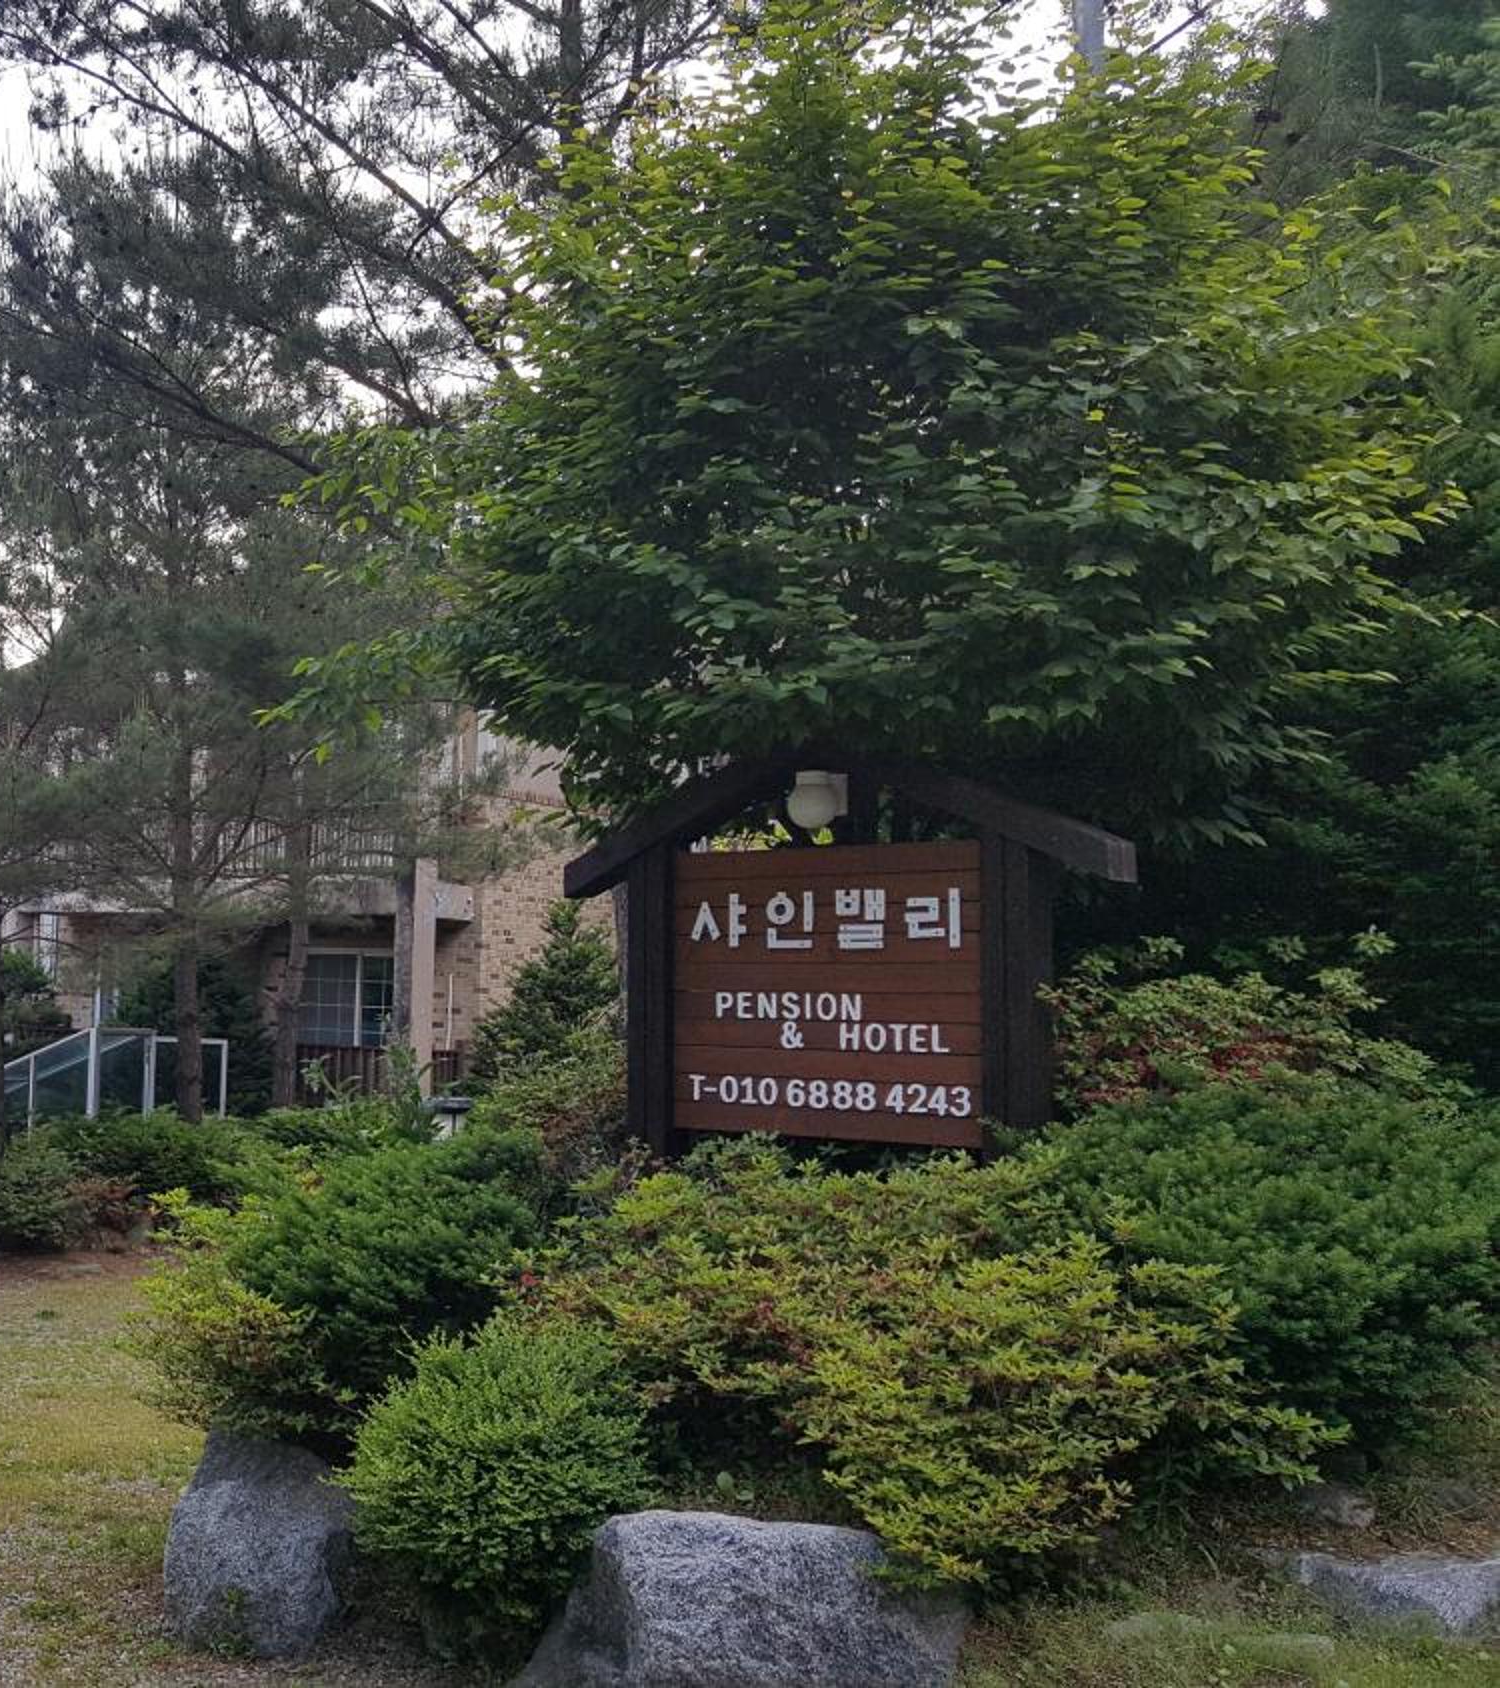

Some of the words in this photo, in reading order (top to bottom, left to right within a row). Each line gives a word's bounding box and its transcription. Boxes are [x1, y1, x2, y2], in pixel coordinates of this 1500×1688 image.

[714, 991, 863, 1022] PENSION
[780, 1020, 805, 1050] &
[838, 1022, 950, 1053] HOTEL
[689, 1074, 779, 1105] T-010
[786, 1079, 877, 1112] 6888
[884, 1083, 972, 1118] 4243
